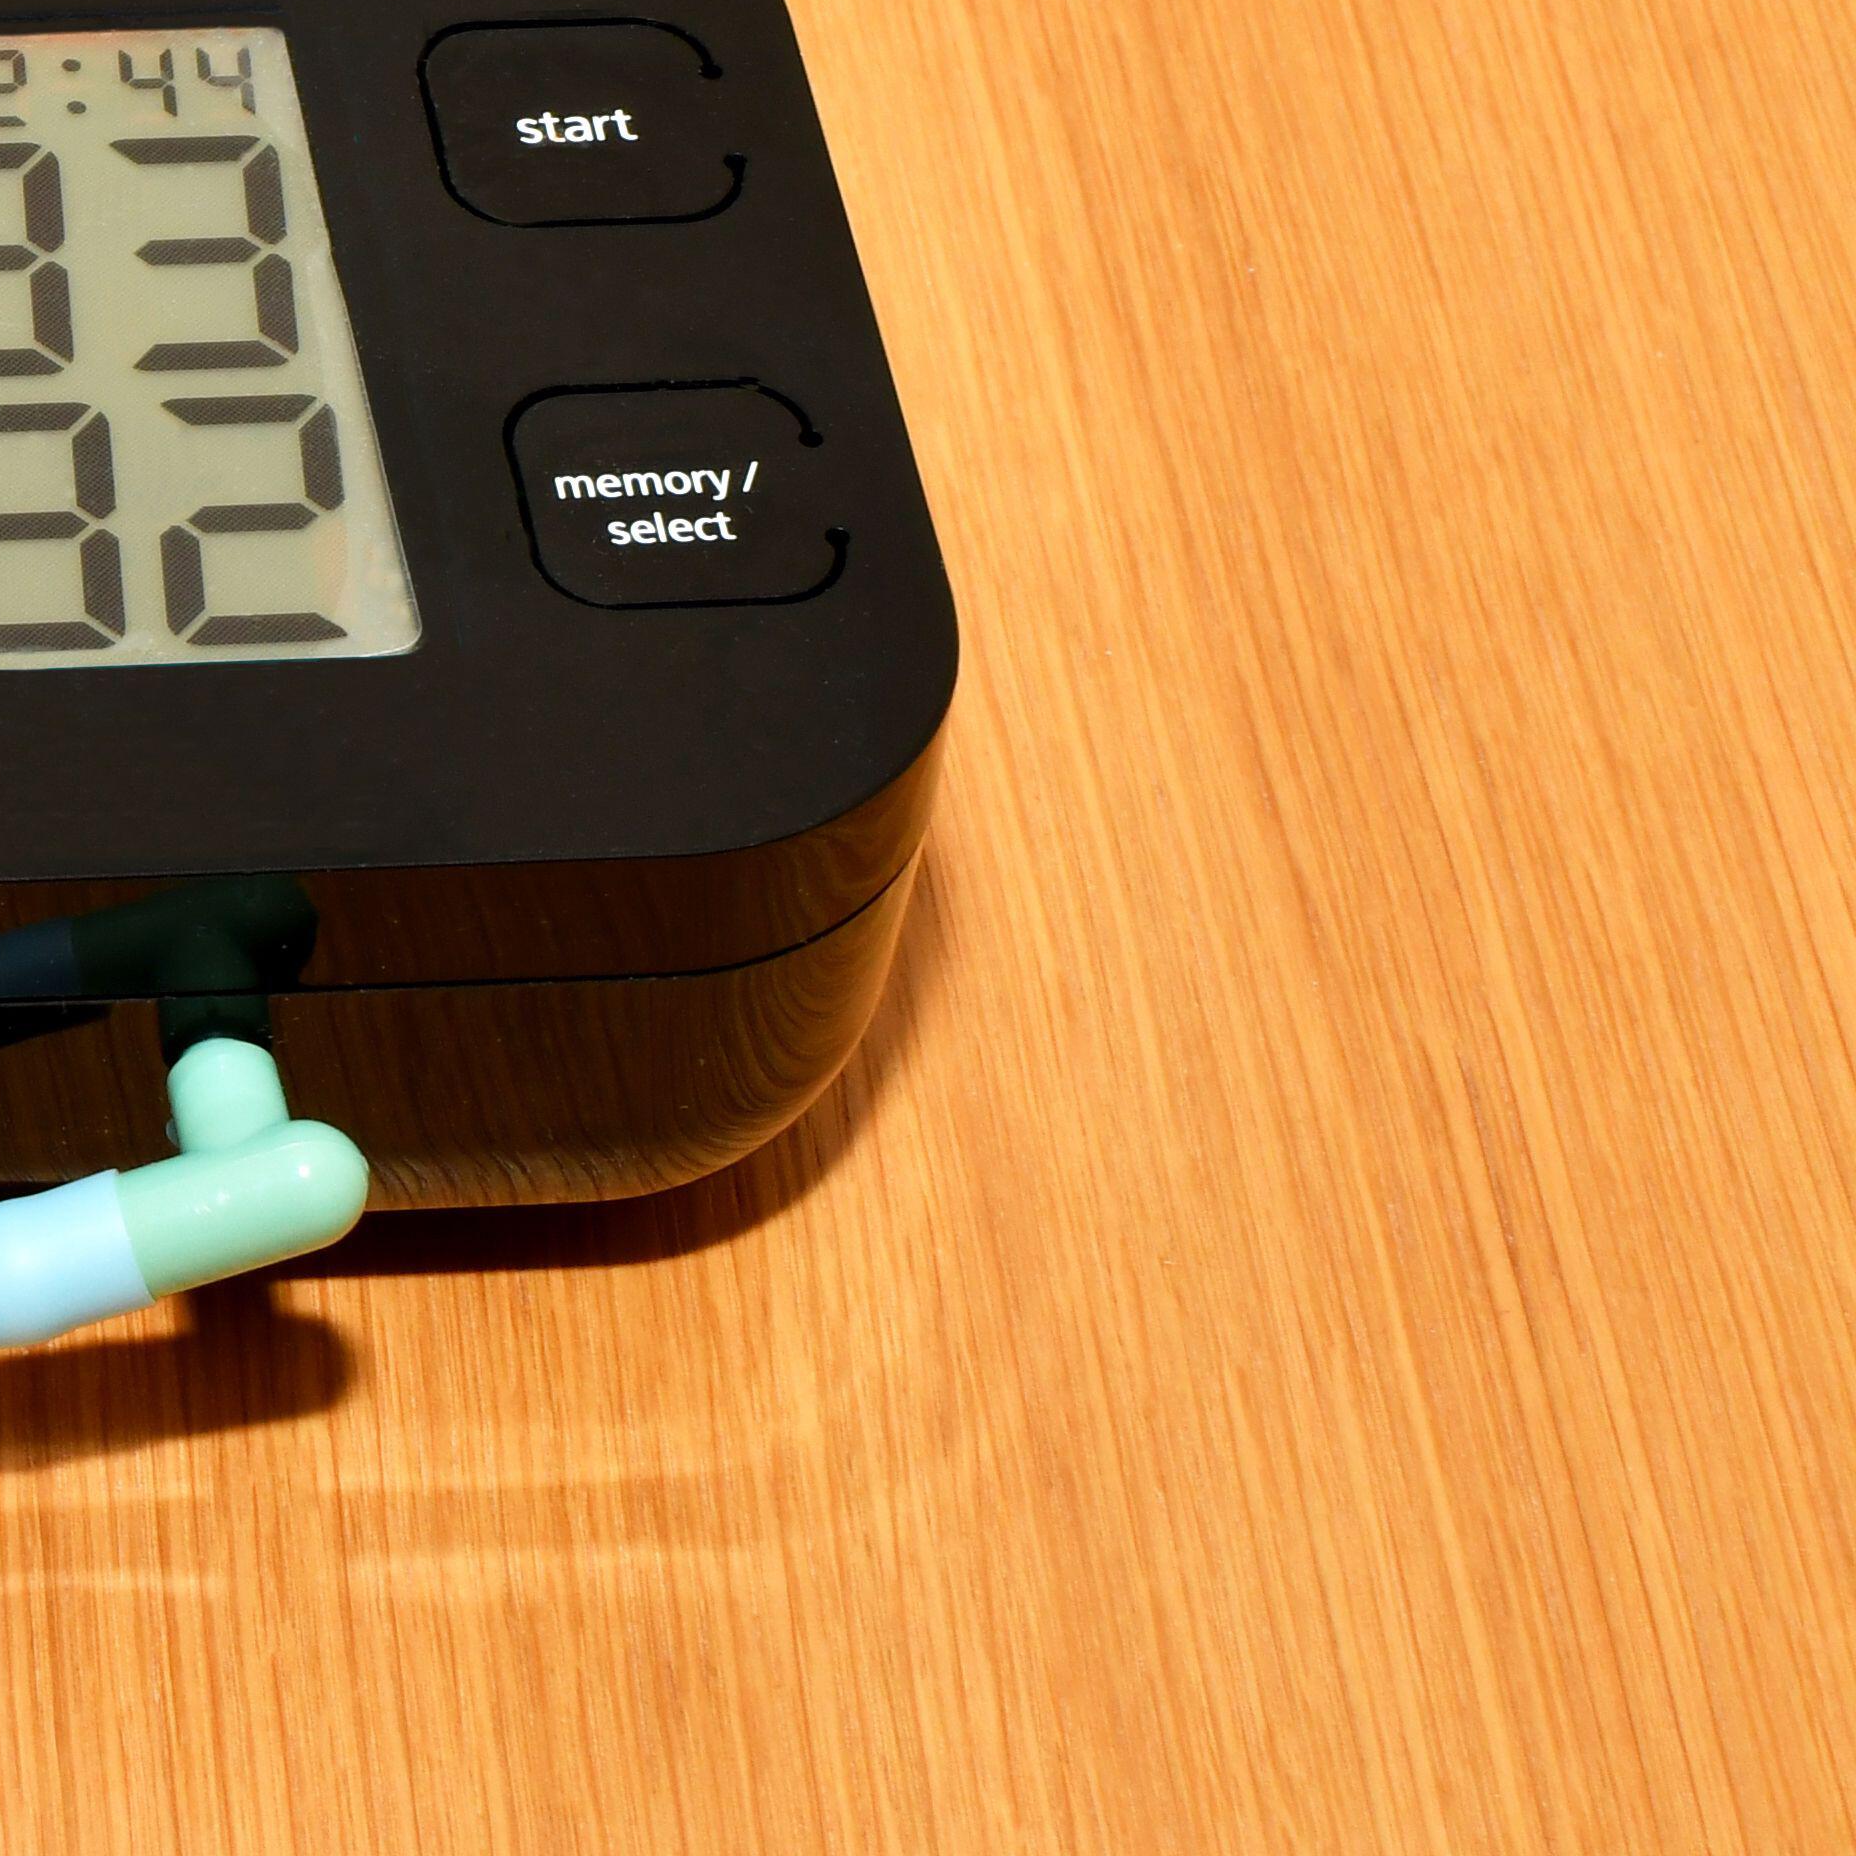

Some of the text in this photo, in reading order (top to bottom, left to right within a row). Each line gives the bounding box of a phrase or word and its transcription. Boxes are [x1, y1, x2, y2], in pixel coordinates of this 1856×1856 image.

[516, 108, 639, 145] start
[554, 469, 731, 501] memory
[607, 511, 738, 546] select
